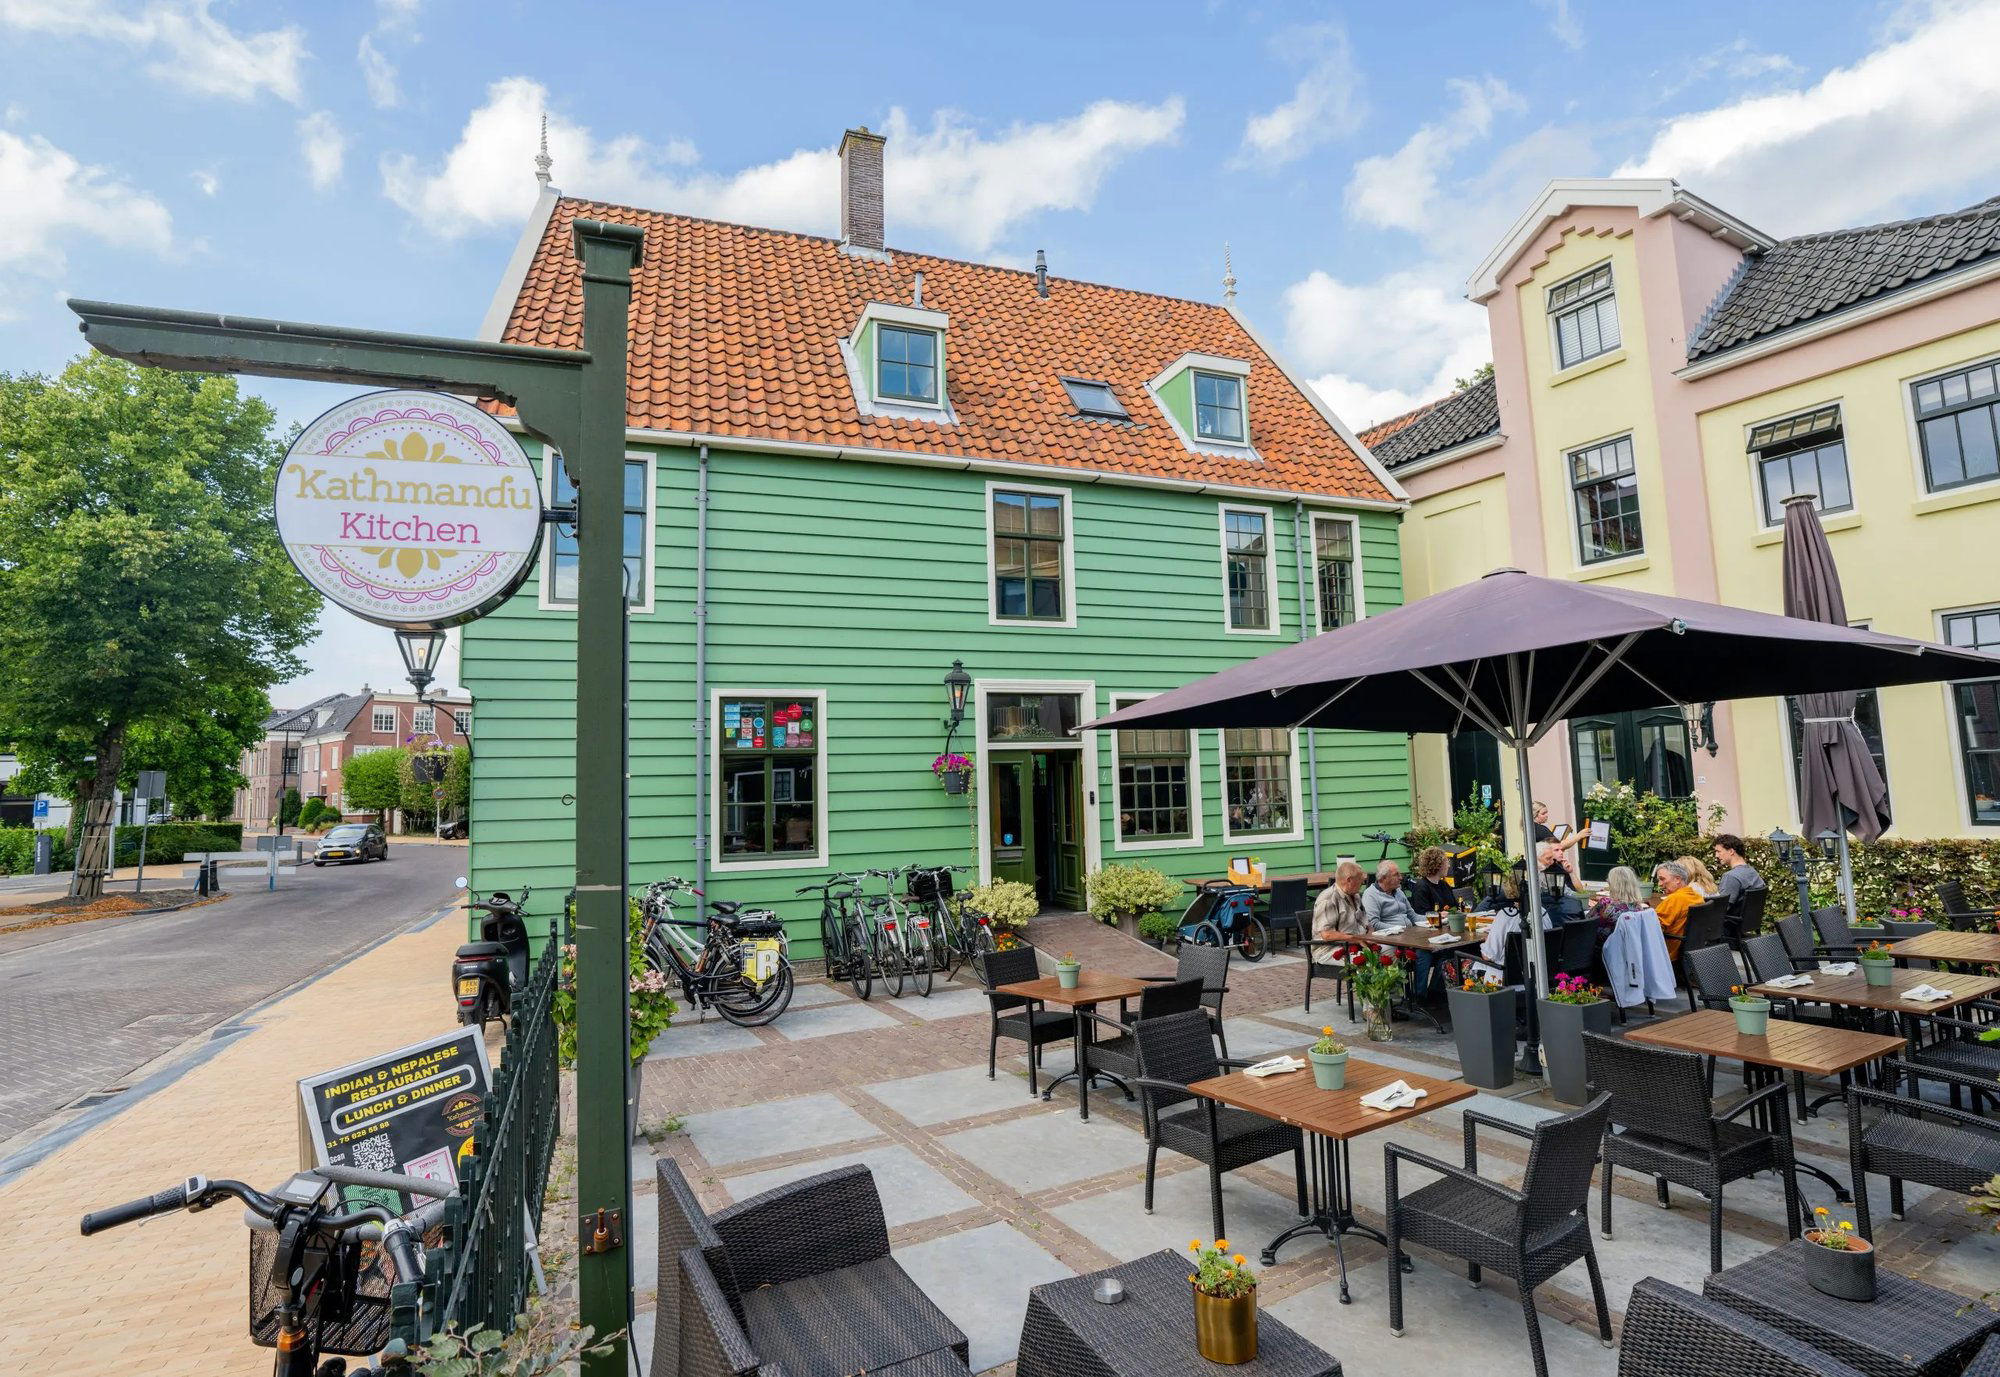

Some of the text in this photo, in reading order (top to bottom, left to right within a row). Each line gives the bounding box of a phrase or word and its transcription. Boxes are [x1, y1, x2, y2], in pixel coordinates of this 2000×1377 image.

[286, 463, 533, 510] Kathmandu
[339, 511, 481, 544] Kitchen
[37, 801, 46, 811] P
[324, 1046, 459, 1099] INDIAN & NEPALESE
[350, 1064, 441, 1103] RESTAURANT
[344, 1075, 462, 1124] LUNCH & DINNER
